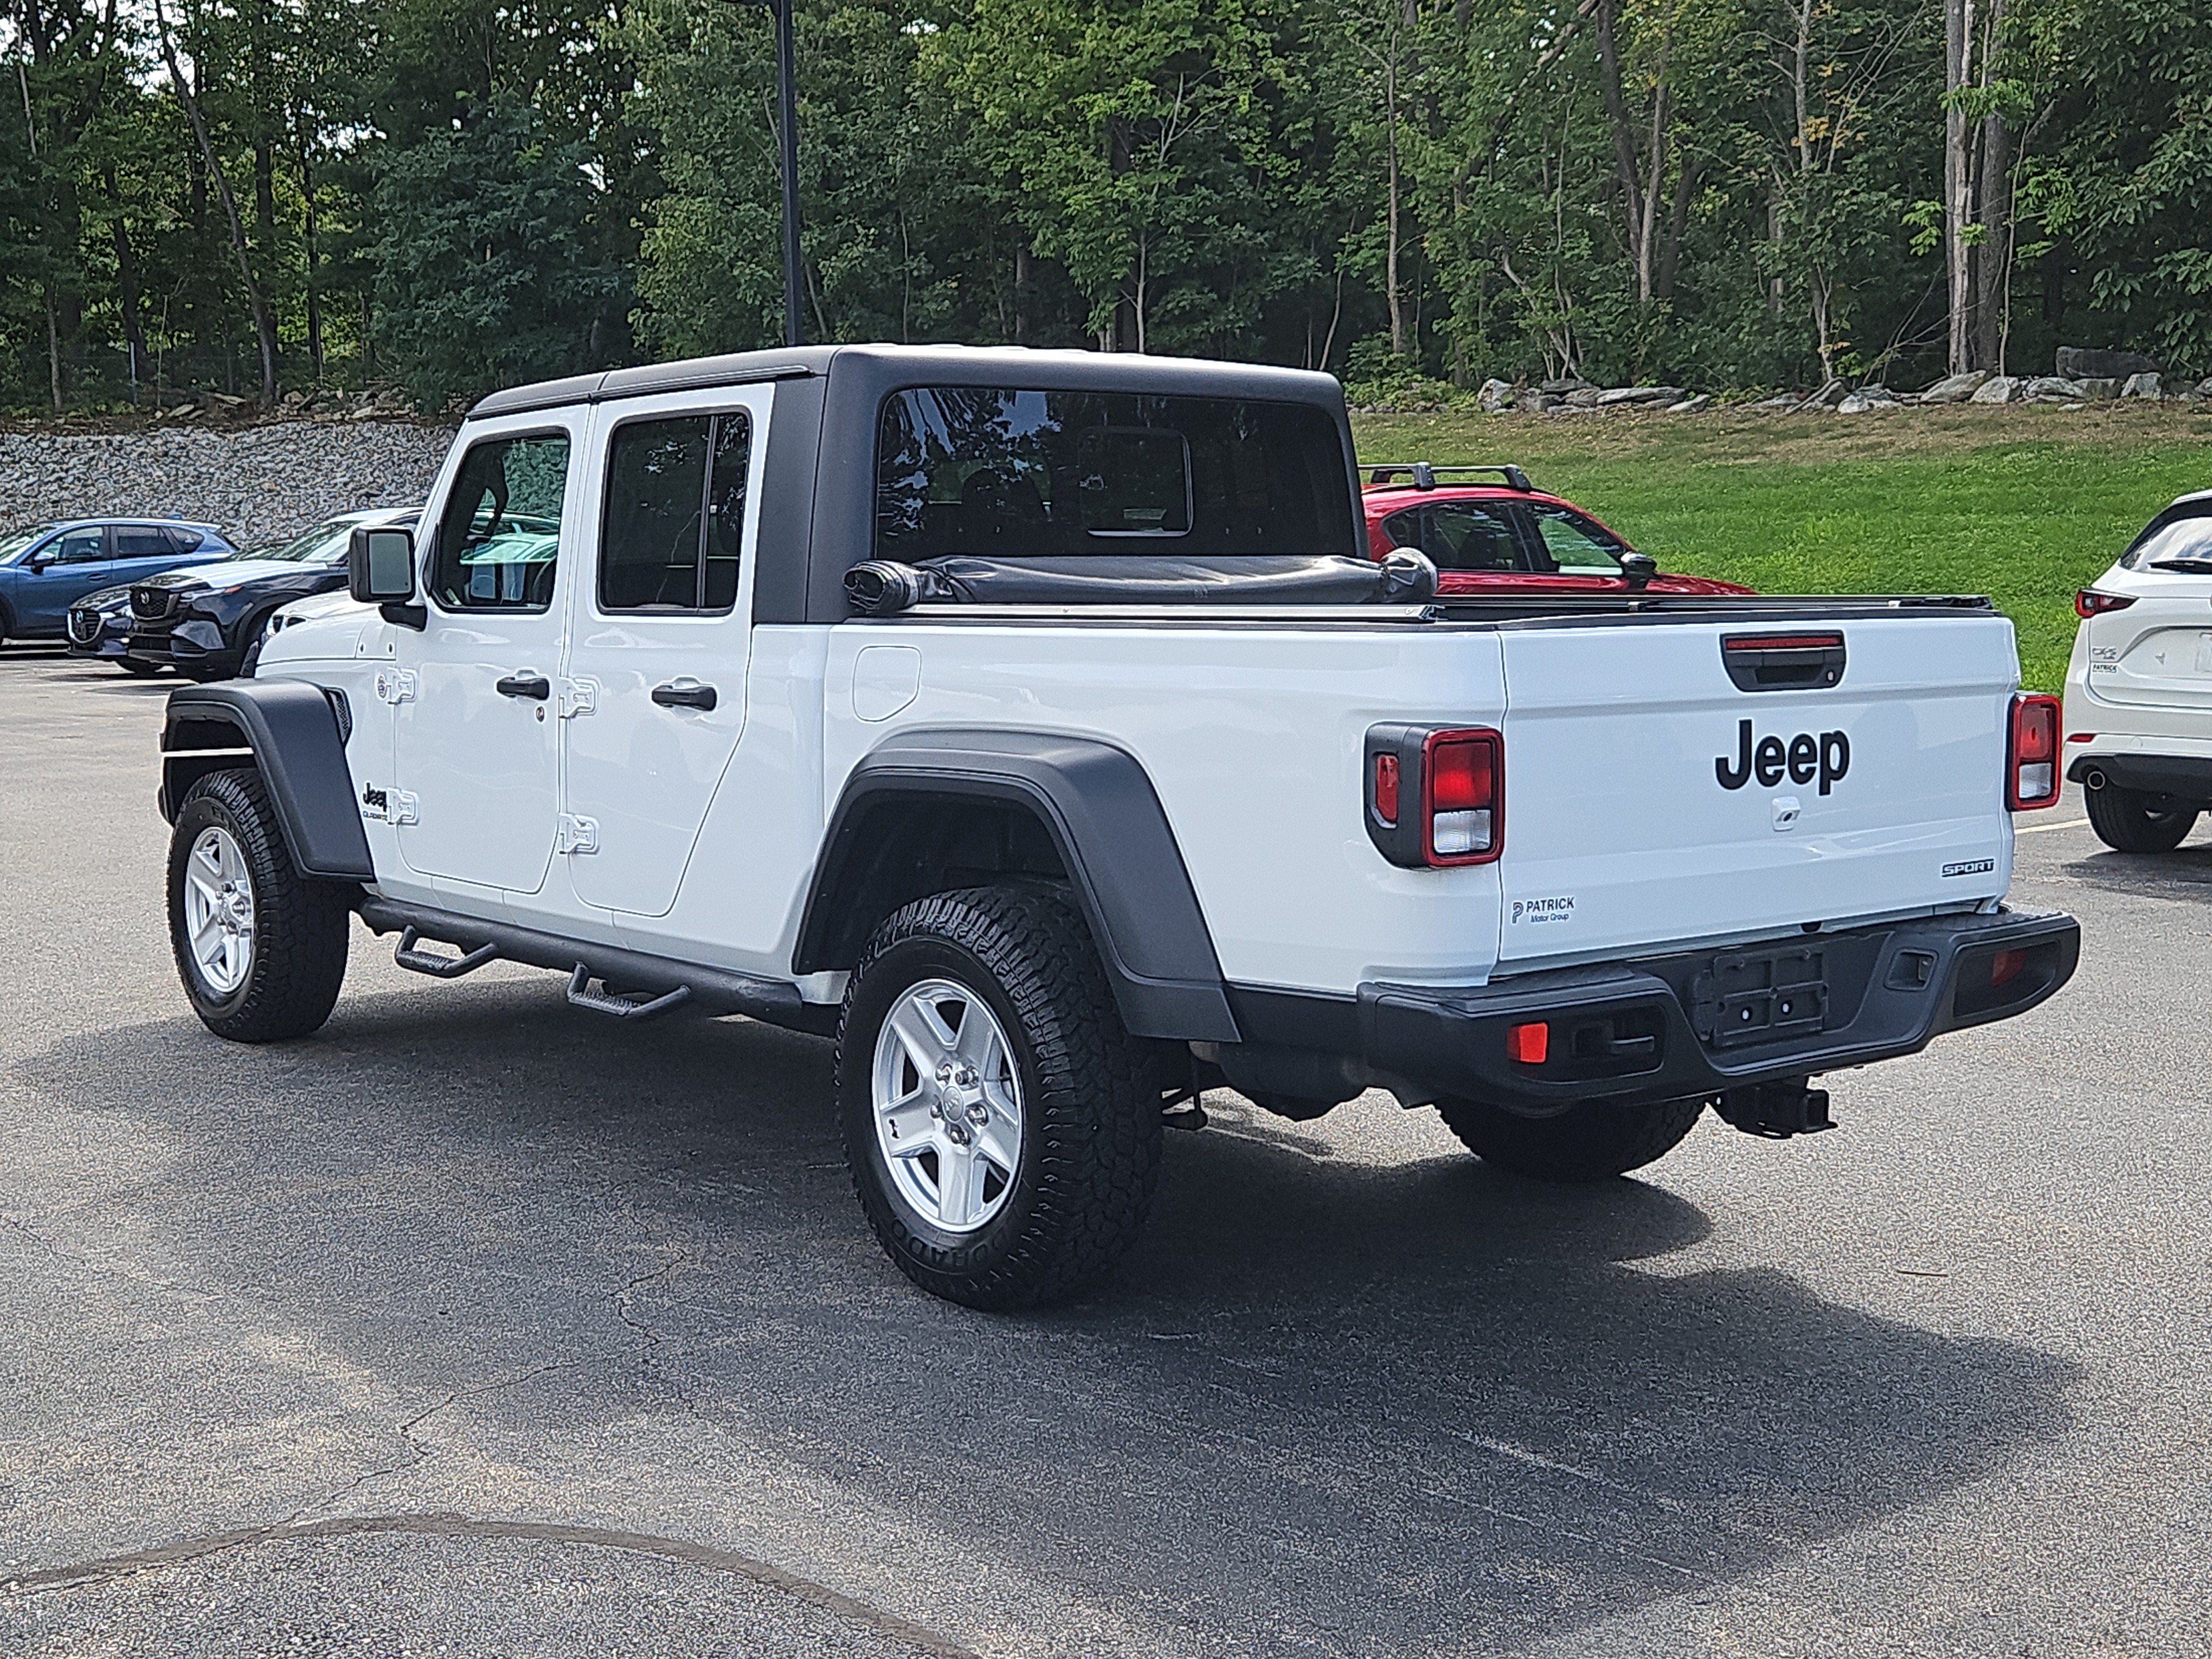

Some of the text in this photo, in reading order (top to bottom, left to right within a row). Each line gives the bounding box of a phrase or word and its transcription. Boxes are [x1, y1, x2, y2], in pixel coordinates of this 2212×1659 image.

[1715, 719, 1850, 796] Jeep
[363, 782, 387, 812] Jeep
[1943, 860, 1994, 874] SPORT
[1526, 897, 1574, 912] PATRICK
[1531, 912, 1569, 923] Motor Group
